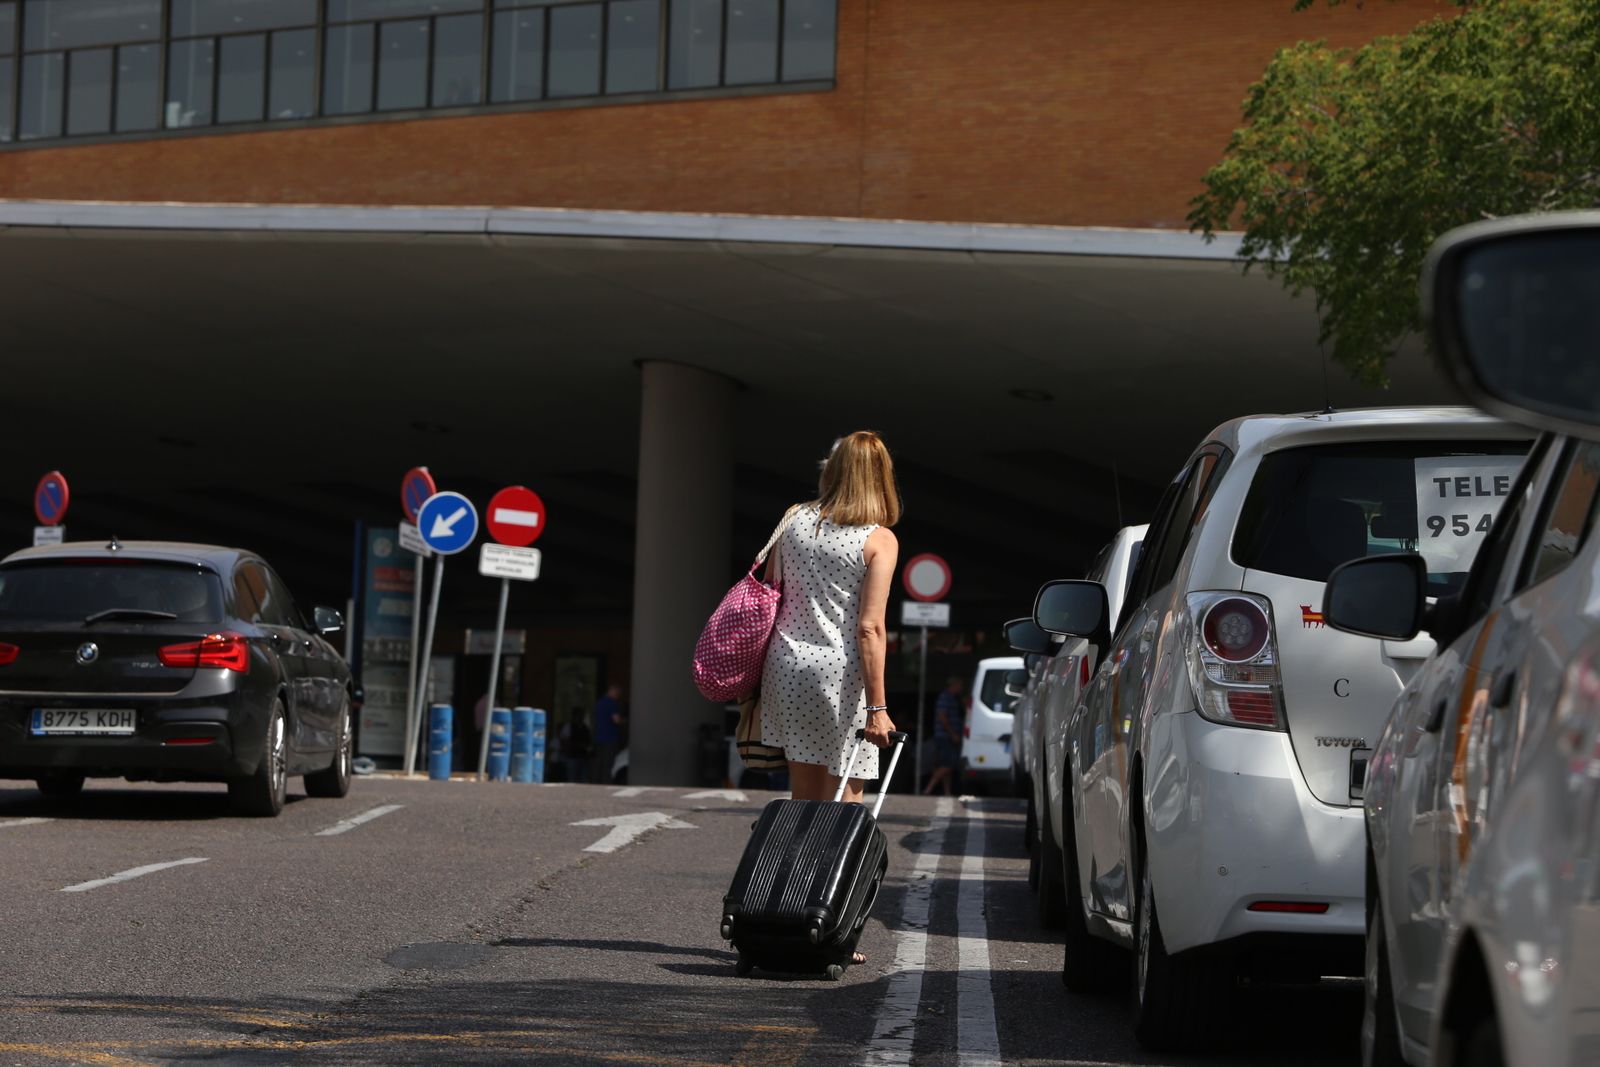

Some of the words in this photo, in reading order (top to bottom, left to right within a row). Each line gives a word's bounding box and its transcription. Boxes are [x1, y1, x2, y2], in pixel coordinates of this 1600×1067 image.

[1433, 475, 1511, 498] TELE
[1333, 677, 1350, 698] C
[43, 711, 89, 727] 8775
[96, 711, 132, 727] KDH
[1314, 736, 1367, 748] TOYOTA
